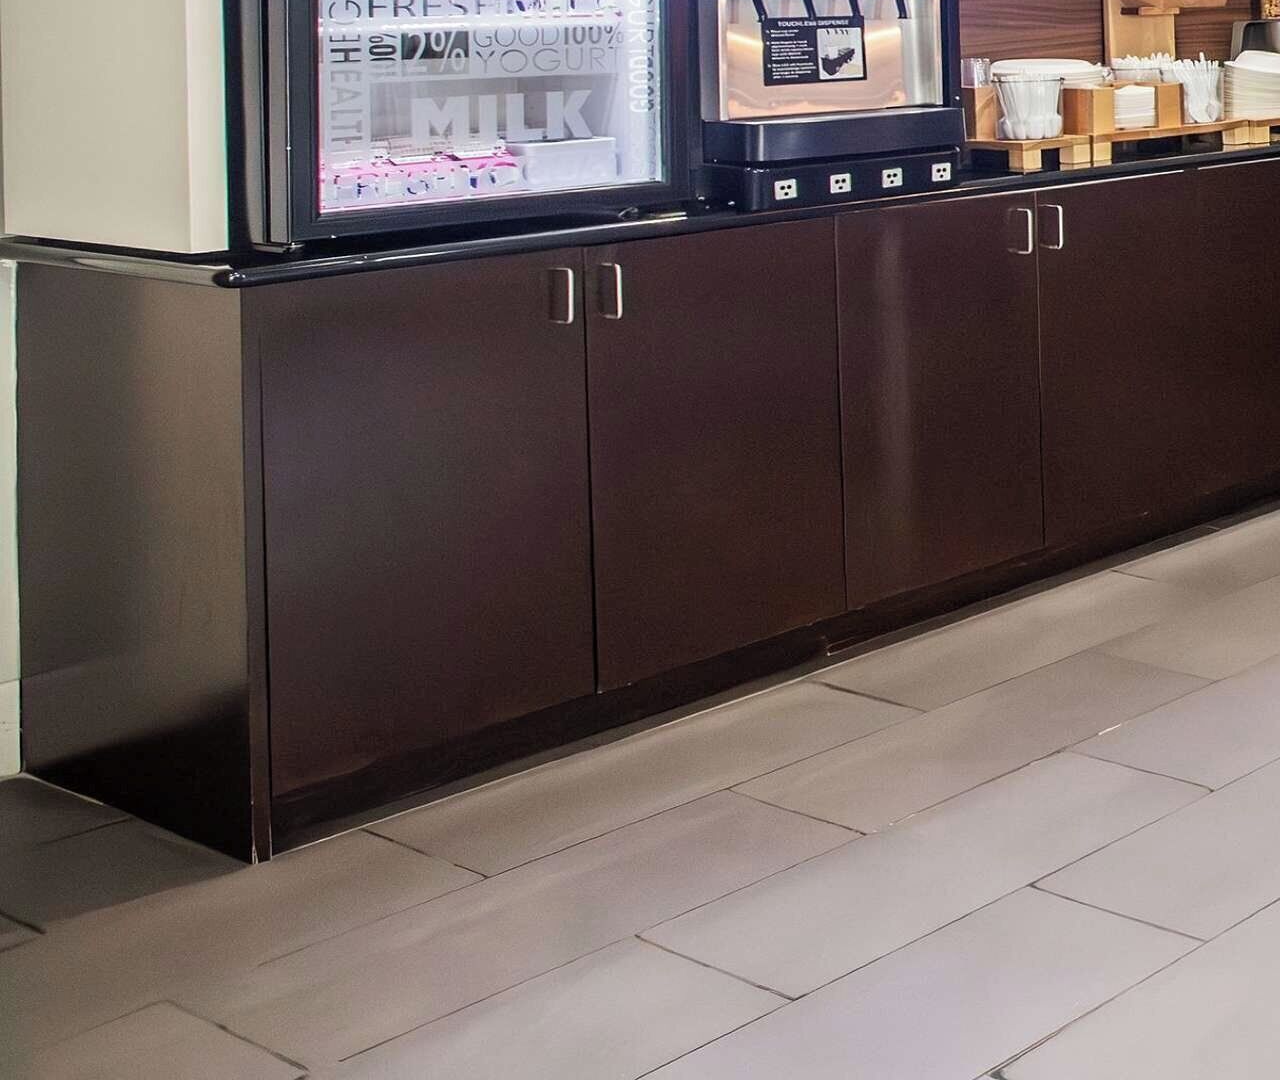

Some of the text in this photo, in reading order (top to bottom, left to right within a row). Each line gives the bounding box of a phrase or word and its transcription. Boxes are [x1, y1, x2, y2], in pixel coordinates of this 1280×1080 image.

[472, 25, 560, 48] GOOD
[475, 46, 622, 73] YOGURT
[411, 88, 595, 147] MILK
